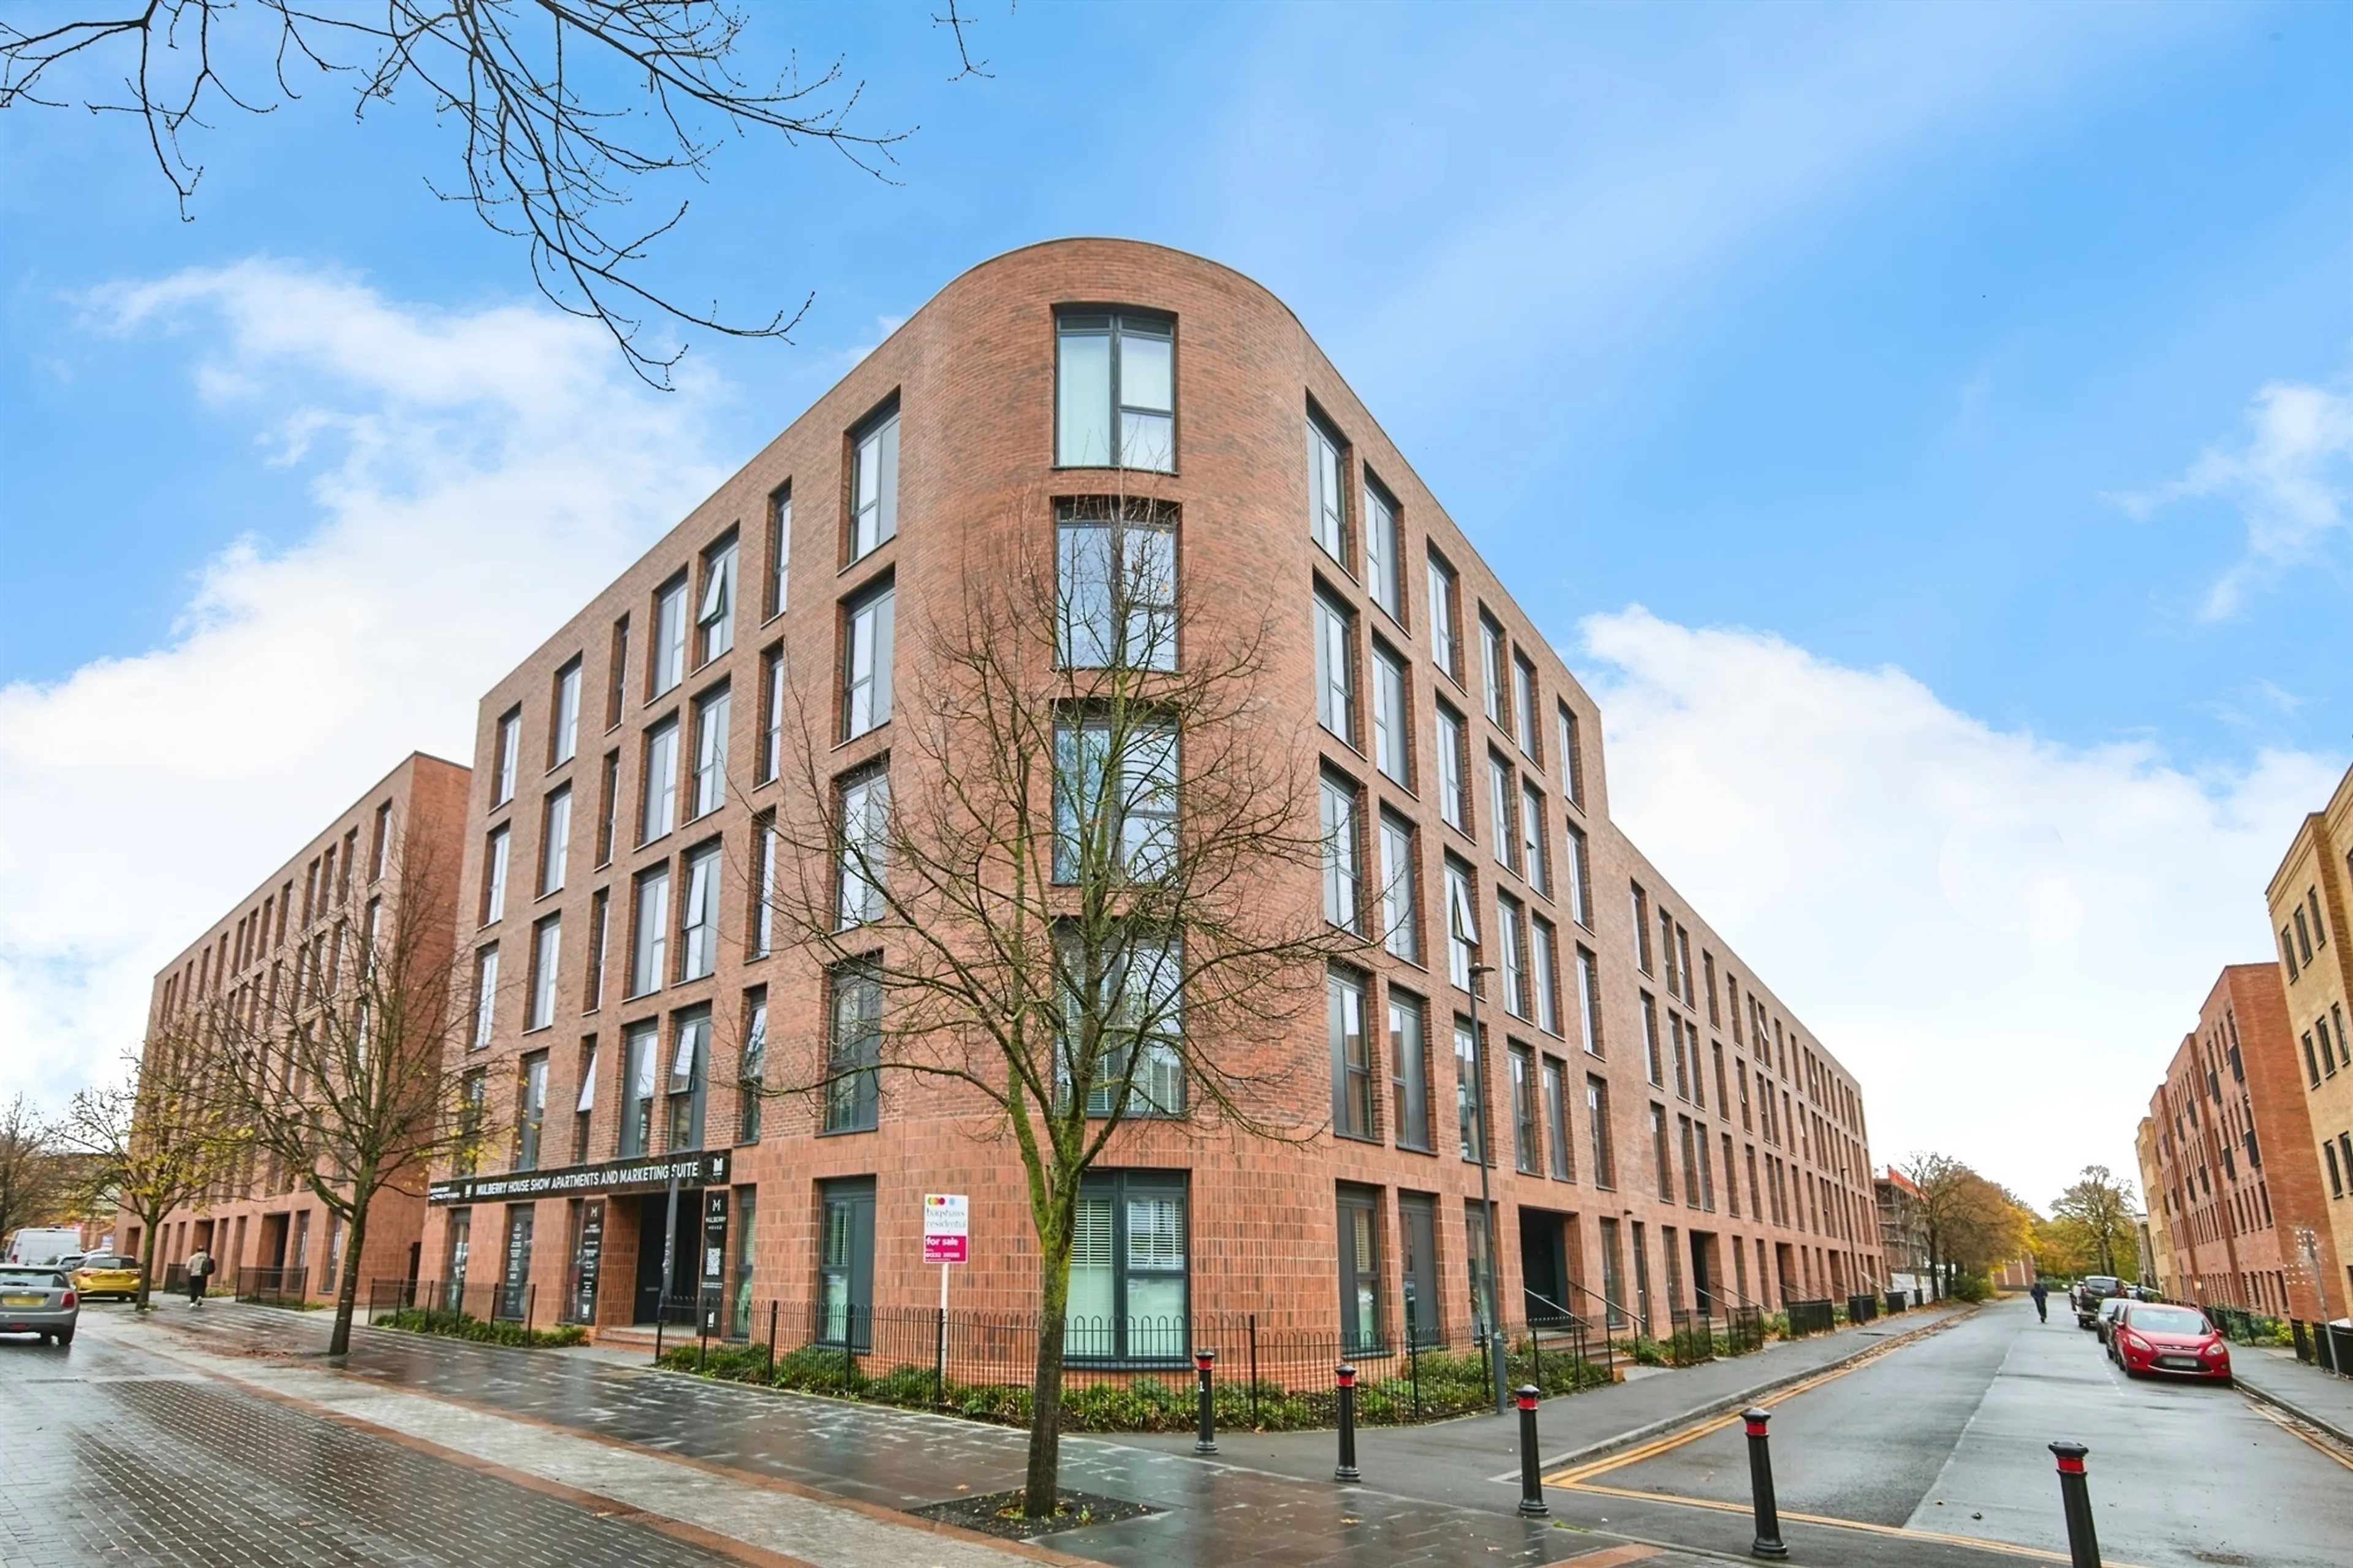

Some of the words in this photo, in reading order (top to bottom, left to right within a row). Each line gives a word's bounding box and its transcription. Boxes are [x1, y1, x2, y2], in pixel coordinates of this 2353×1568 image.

[476, 1182, 507, 1195] MULBERRY
[508, 1179, 530, 1193] HOUSE
[531, 1178, 550, 1191] SHOW
[551, 1172, 599, 1189] APARTMENTS
[601, 1170, 618, 1185] AND
[620, 1165, 669, 1183] MARKETING
[672, 1162, 698, 1178] SUITE
